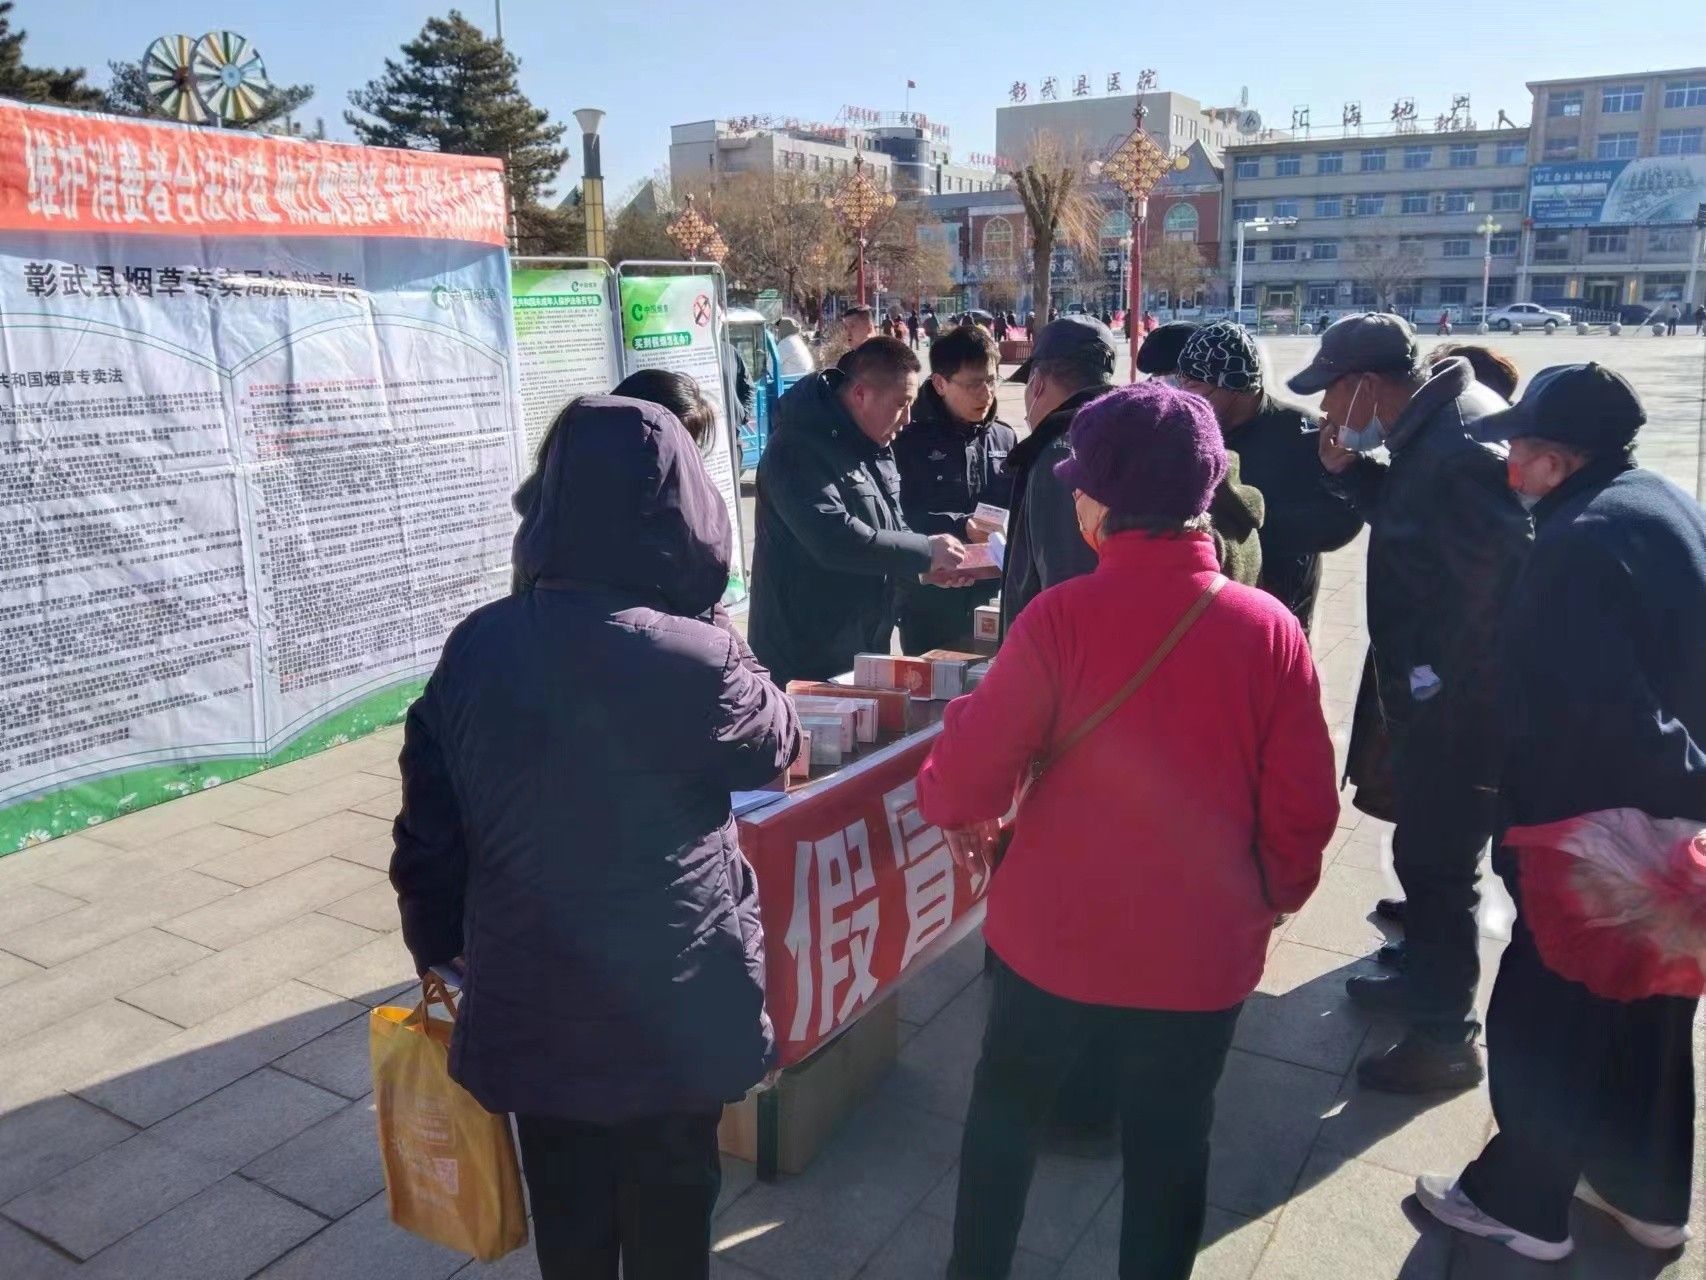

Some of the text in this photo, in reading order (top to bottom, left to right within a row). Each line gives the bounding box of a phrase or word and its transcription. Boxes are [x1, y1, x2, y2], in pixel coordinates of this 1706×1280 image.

[1008, 68, 1158, 103] 彰武县医院
[1291, 95, 1470, 130] 汇海地产
[0, 367, 124, 390] 共和国烟草专卖法
[784, 779, 991, 1041] 假冒
